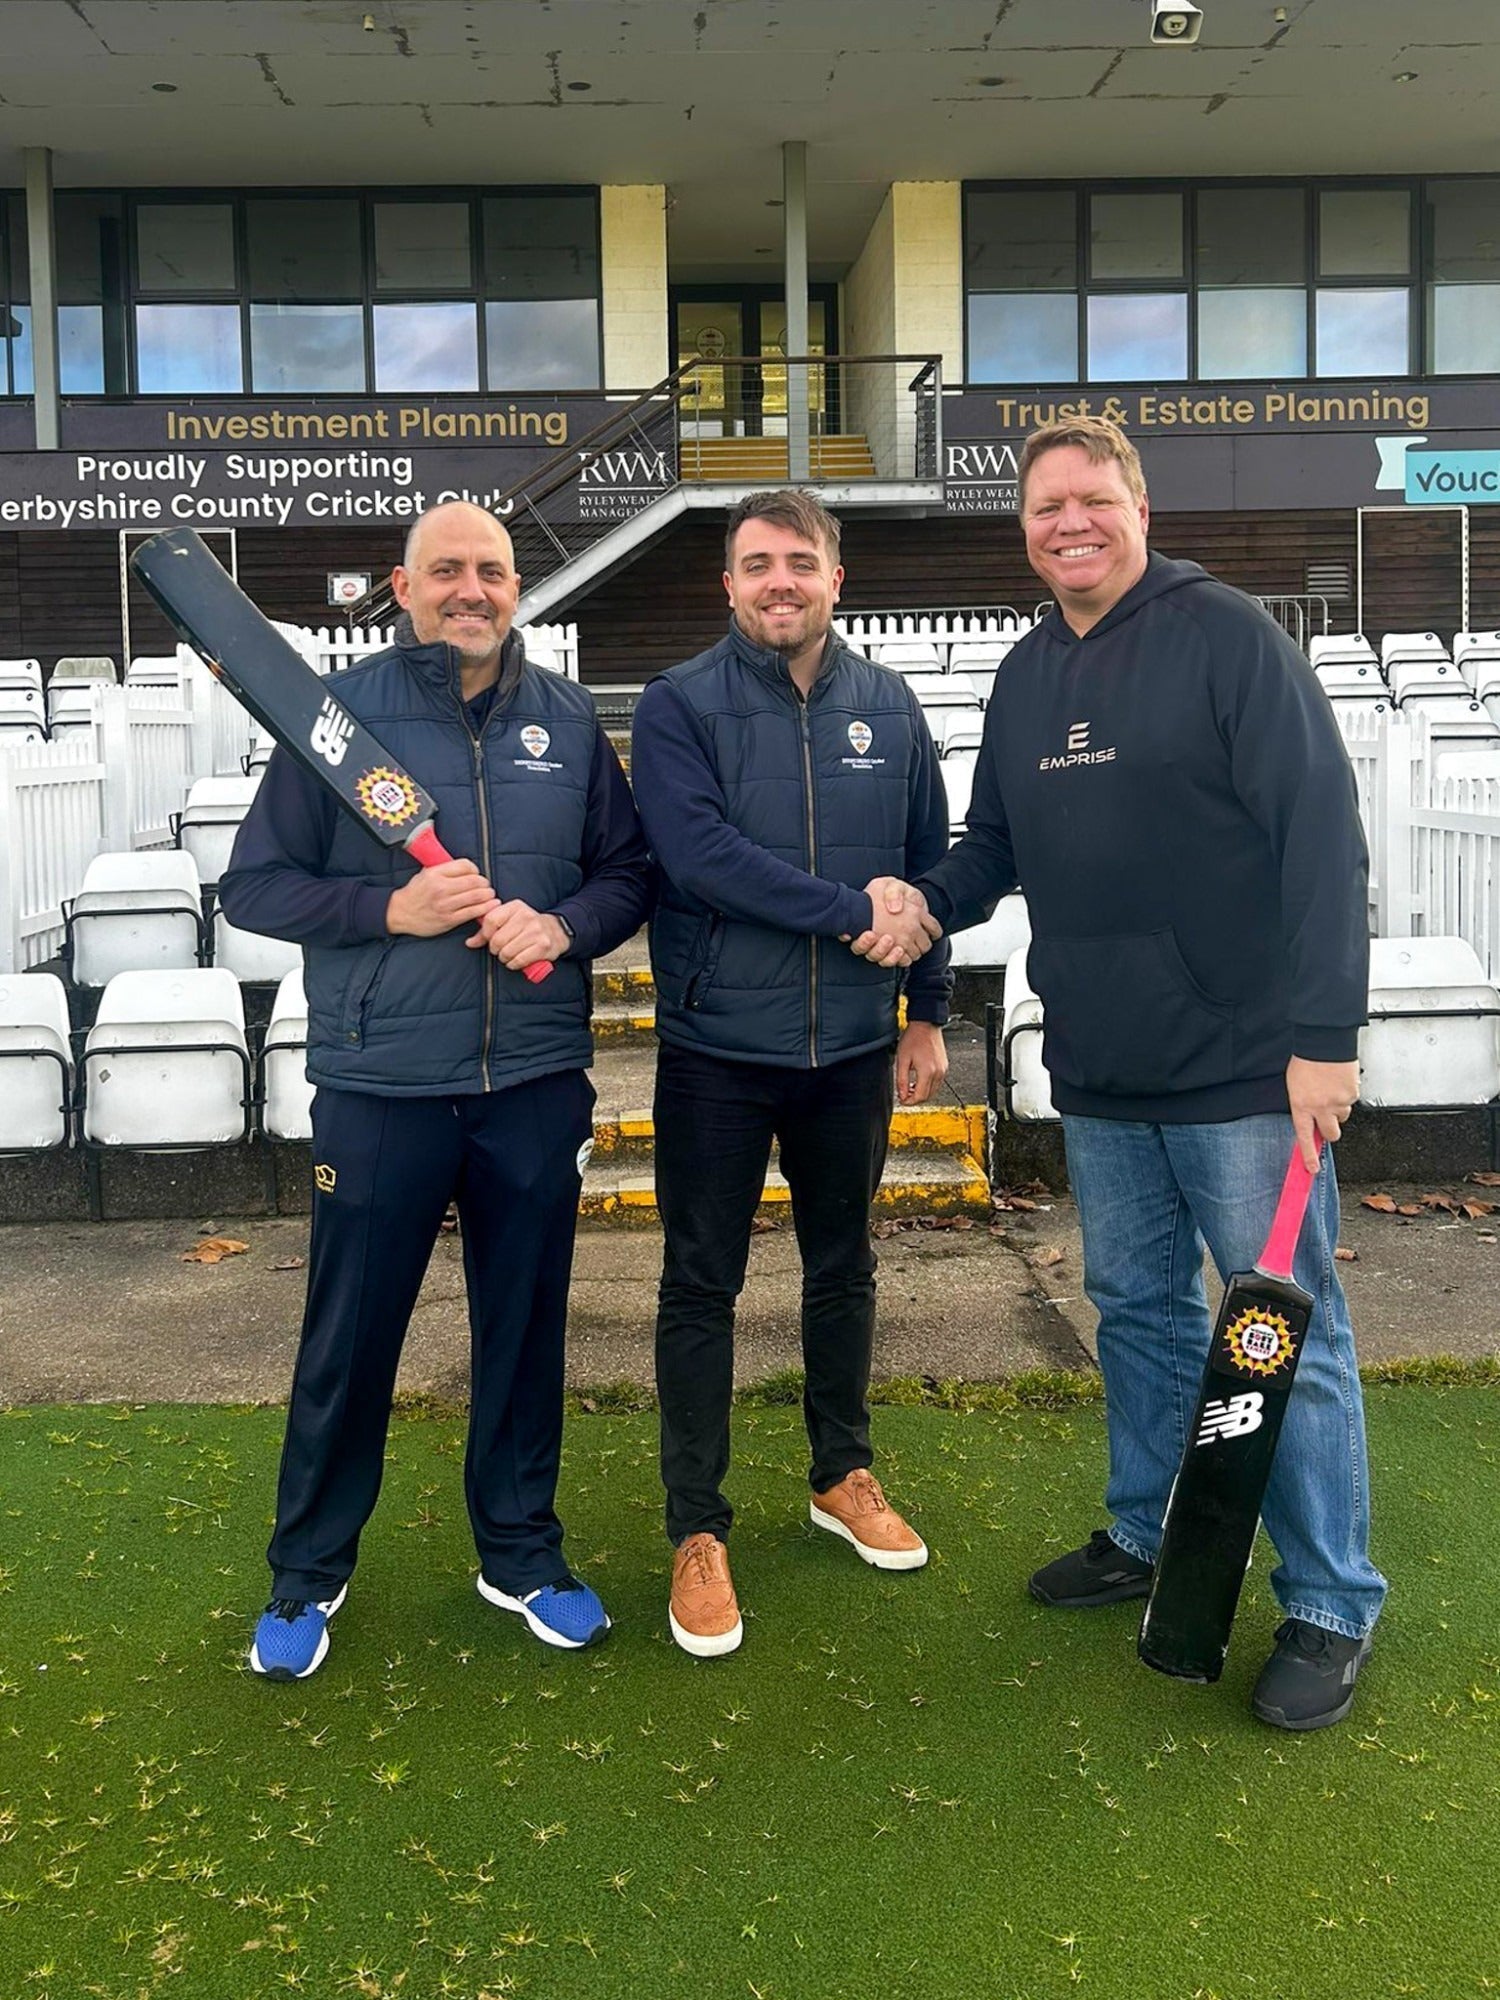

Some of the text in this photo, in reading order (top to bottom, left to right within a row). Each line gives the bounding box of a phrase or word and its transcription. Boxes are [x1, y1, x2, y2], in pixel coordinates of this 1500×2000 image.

[167, 404, 569, 446] Investment Planning
[996, 389, 1429, 430] Trust & Estate Planning
[77, 450, 412, 488] Proudly Supporting
[1, 492, 161, 528] erbyshire
[171, 493, 294, 525] County
[306, 489, 426, 517] Cricket
[579, 496, 616, 506] RYLEY
[946, 489, 983, 499] RYLEY
[1039, 747, 1116, 770] EMPRISE
[1195, 1391, 1264, 1446] NB
